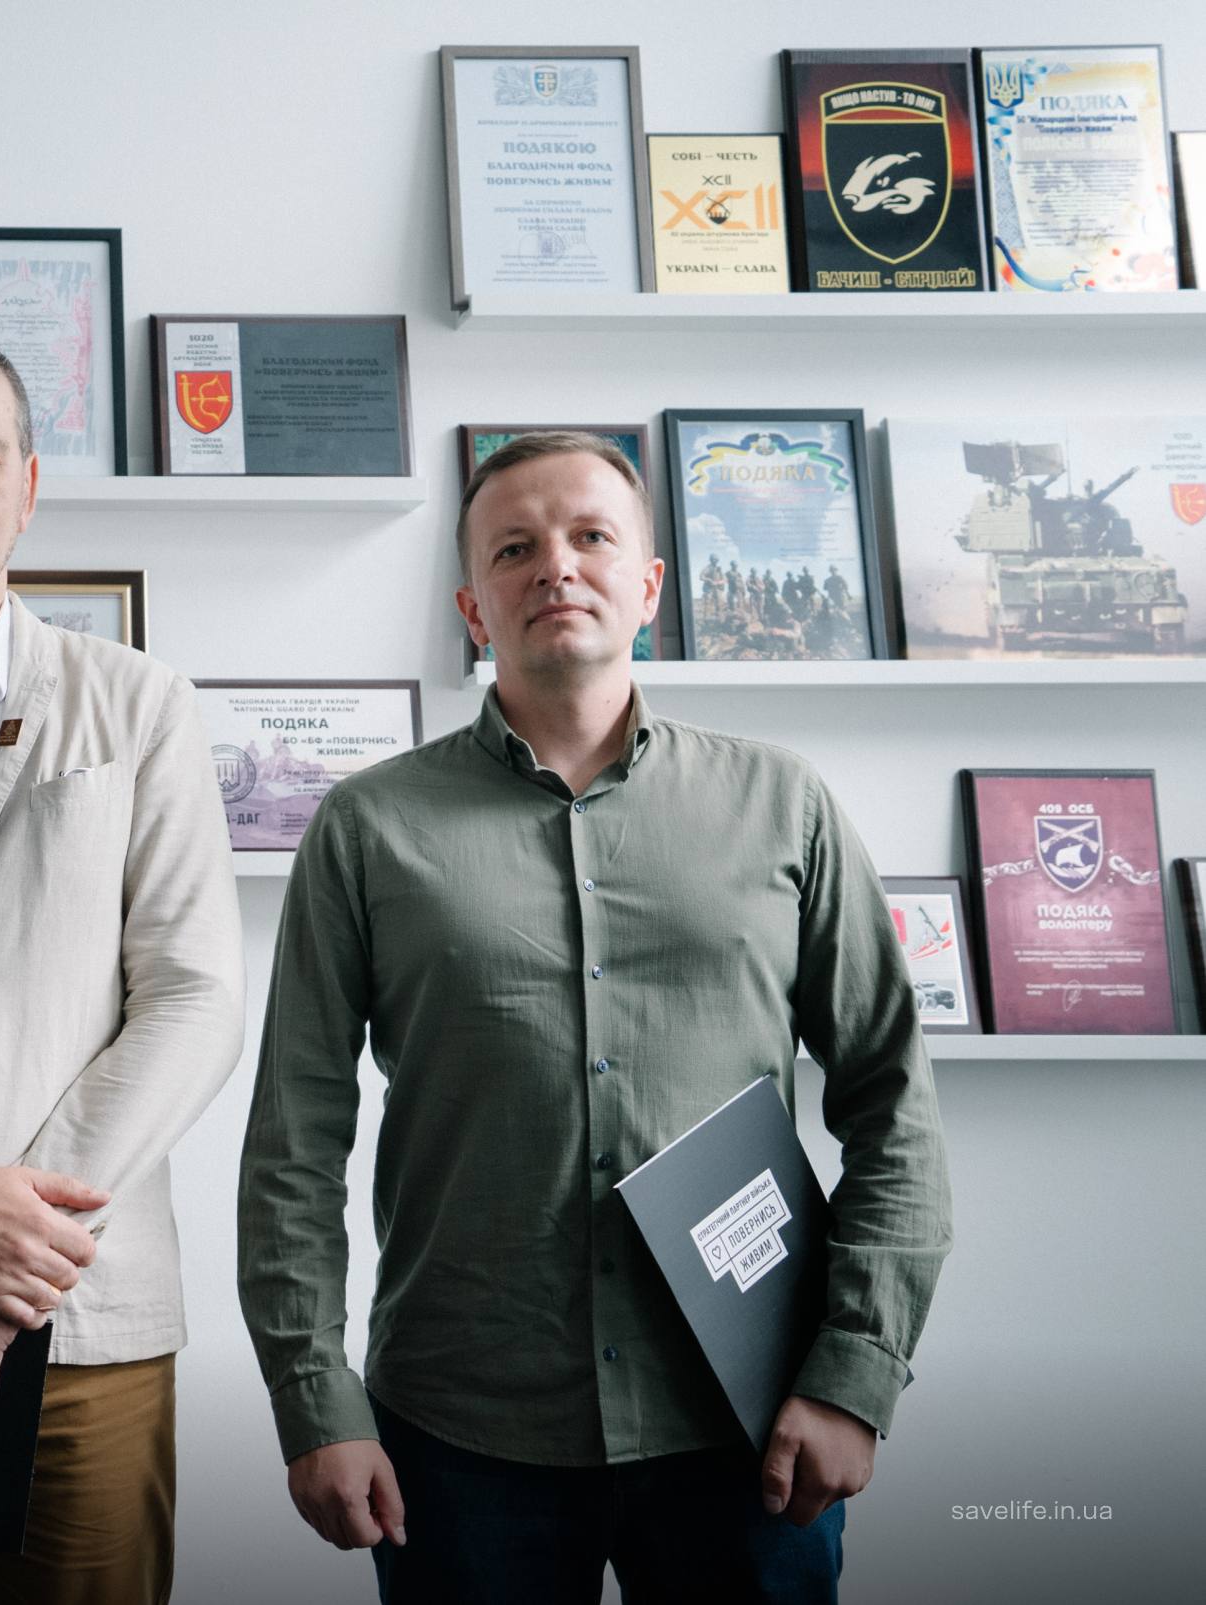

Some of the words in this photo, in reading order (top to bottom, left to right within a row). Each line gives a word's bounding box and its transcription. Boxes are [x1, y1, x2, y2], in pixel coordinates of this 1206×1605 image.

[831, 92, 859, 109] ЯКЩО
[860, 90, 896, 103] НАСТУП
[903, 92, 915, 105] ТО
[915, 95, 936, 111] МИ!
[1040, 95, 1128, 111] ПОДЯКА
[503, 142, 597, 154] ПОДЯКОЮ
[671, 152, 701, 160] СОБІ
[716, 152, 758, 160] ЧЕСТЬ
[666, 264, 718, 273] УКРАЇНІ
[734, 264, 777, 273] СЛАВА
[816, 270, 881, 288] БАЧИШ
[895, 267, 976, 289] СТРІЛЯЙ!
[720, 465, 816, 484] ПОДЯКА
[260, 717, 330, 731] ПОДЯКА
[282, 736, 298, 744] БО
[326, 736, 398, 745] «ПОВЕРНИСЬ
[316, 748, 365, 756] ЖИВИМ»
[1038, 803, 1063, 814] 409
[1068, 803, 1094, 814] ОСБ
[1037, 904, 1112, 919] ПОДЯКА
[1038, 919, 1113, 931] волонтеру
[697, 1209, 731, 1242] СТРАТЕГІЧНИЙ
[729, 1194, 752, 1216] ПАРТНЕР
[750, 1178, 772, 1199] ВІЙСЬКА
[728, 1203, 777, 1248] ПОВЕРНИСЬ
[740, 1238, 773, 1273] ЖИВИМ
